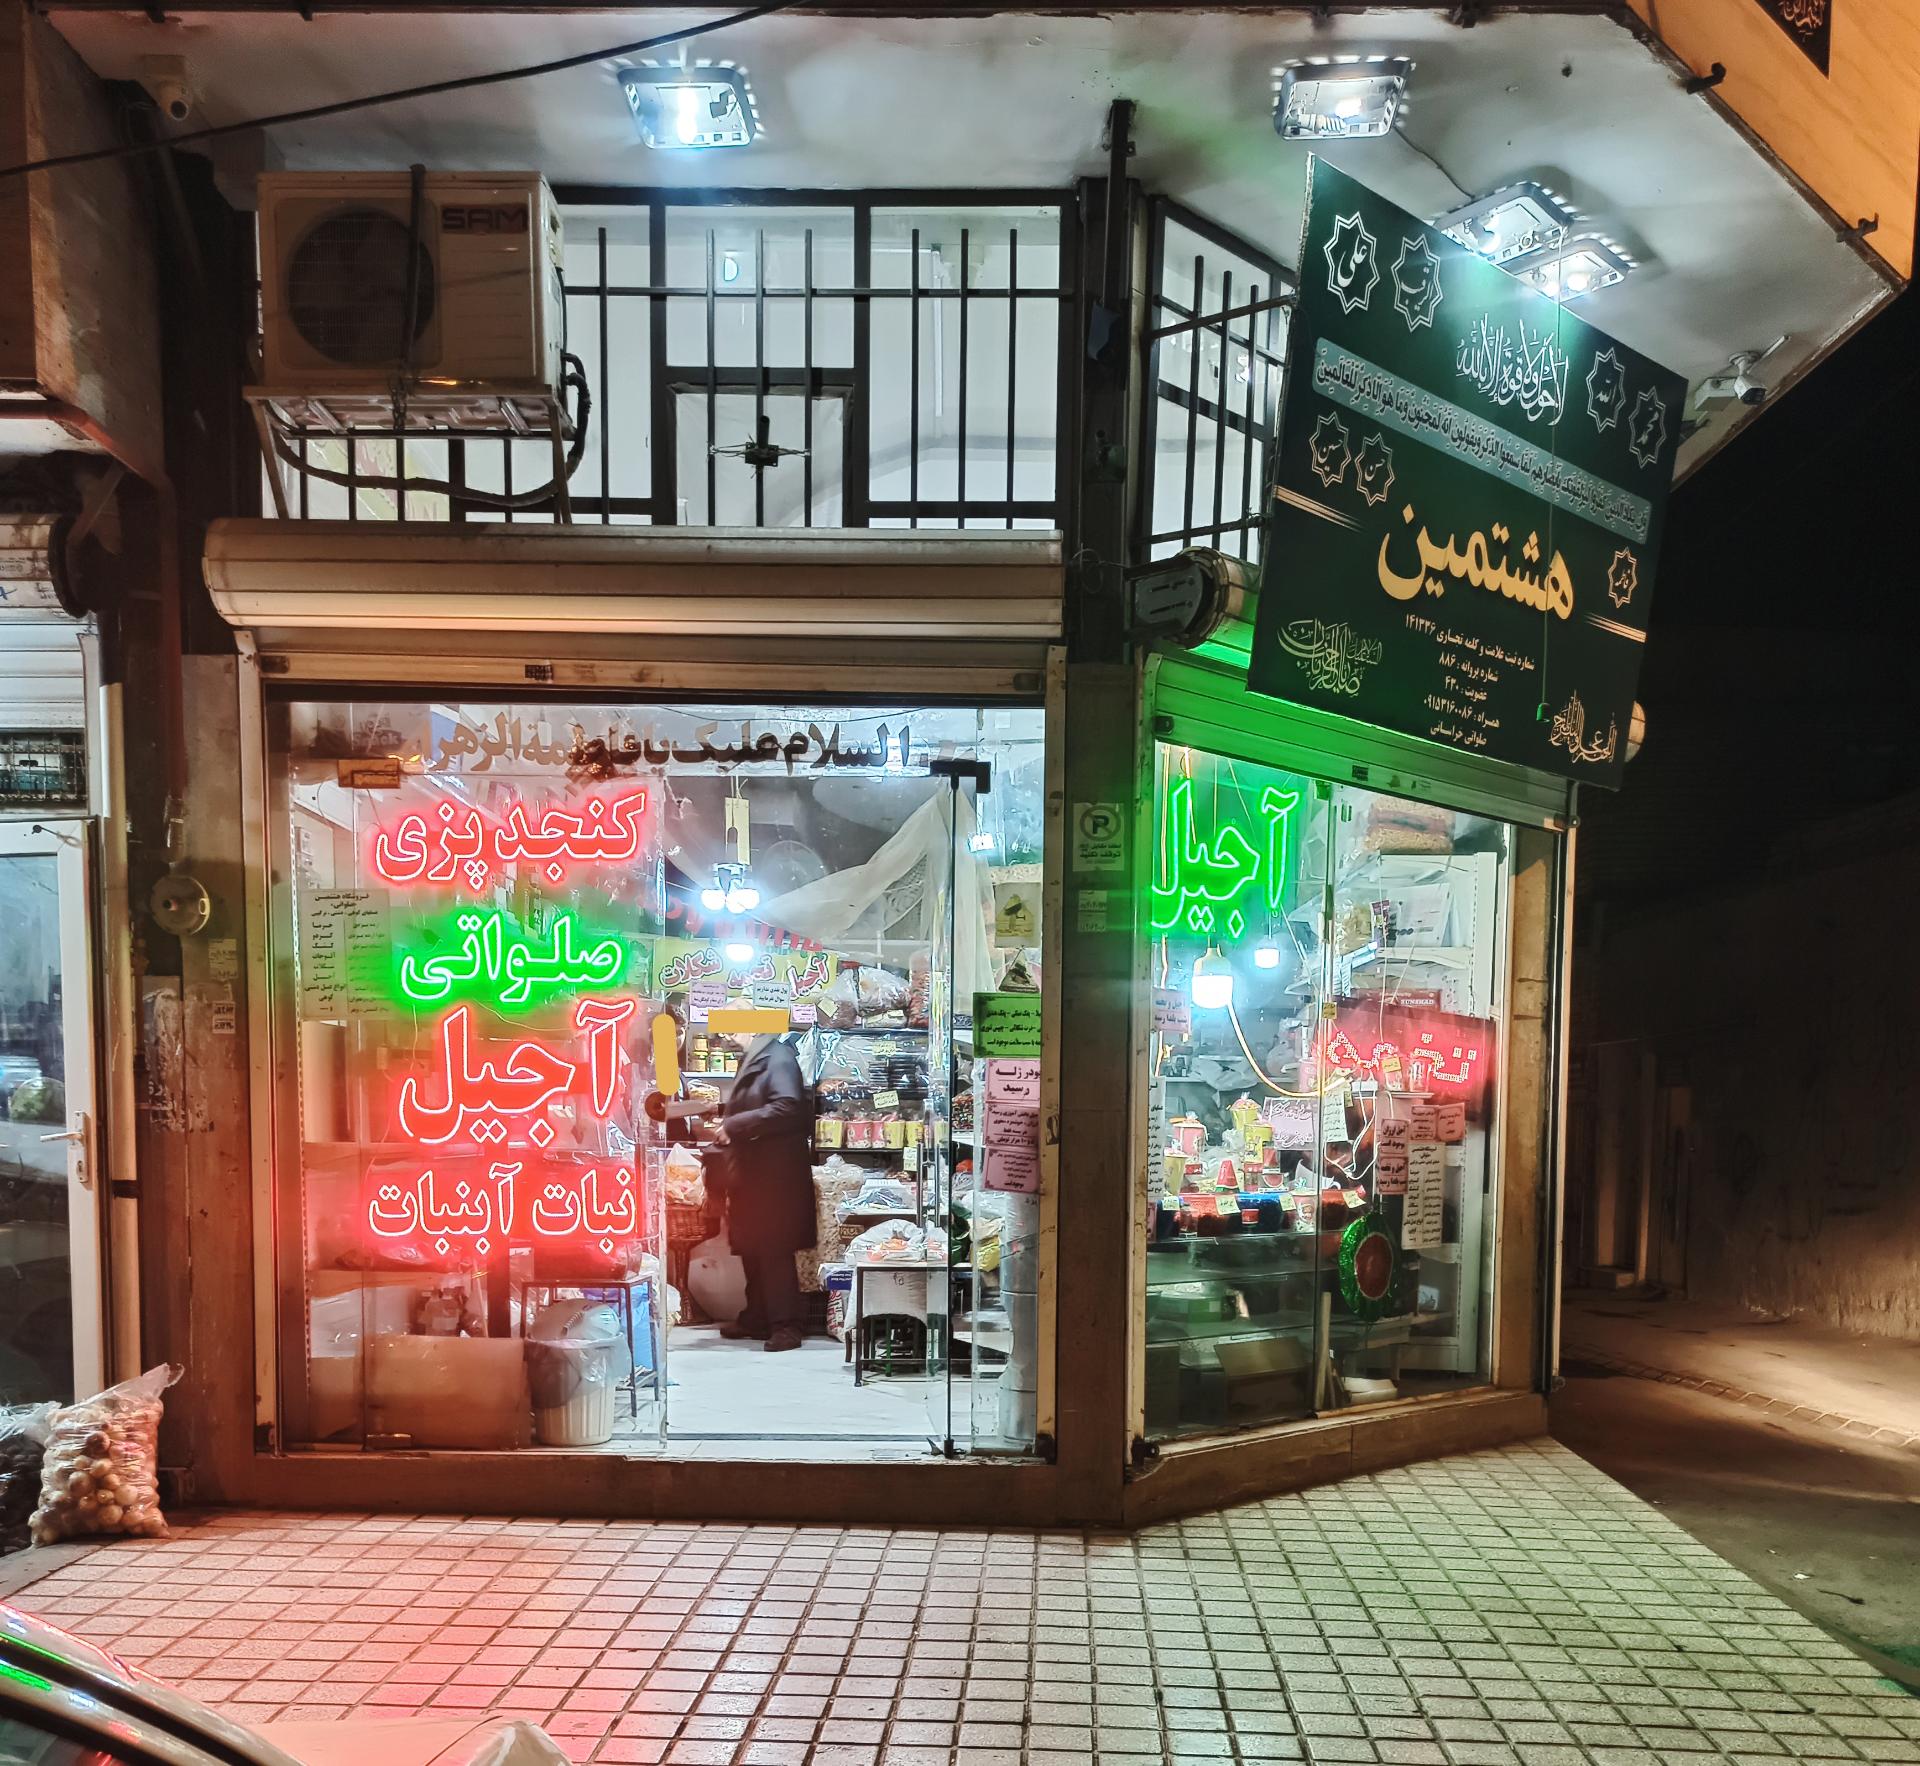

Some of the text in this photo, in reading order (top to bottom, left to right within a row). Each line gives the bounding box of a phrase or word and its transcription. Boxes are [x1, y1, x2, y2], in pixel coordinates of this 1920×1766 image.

[442, 207, 527, 230] SAM
[1337, 234, 1368, 288] علی
[1594, 379, 1618, 407] الله
[1636, 407, 1659, 445] محمد
[1317, 439, 1343, 473] حسین
[1364, 458, 1386, 482] حسن
[1377, 503, 1574, 620] هشتمین
[1482, 667, 1499, 682] شماره
[1519, 655, 1535, 671] شماره
[643, 720, 670, 777] یا
[671, 718, 780, 774] علیک
[783, 720, 910, 777] السلام
[1430, 720, 1464, 741] خراسانی
[375, 792, 646, 890] کنجد پزی
[1151, 779, 1300, 938] آجیل
[400, 913, 623, 1003] صلواتی
[658, 947, 724, 989] شکلات
[399, 999, 636, 1148] آجیل
[1002, 1083, 1030, 1097] رسید
[368, 1162, 637, 1255] نبات آبنبات
